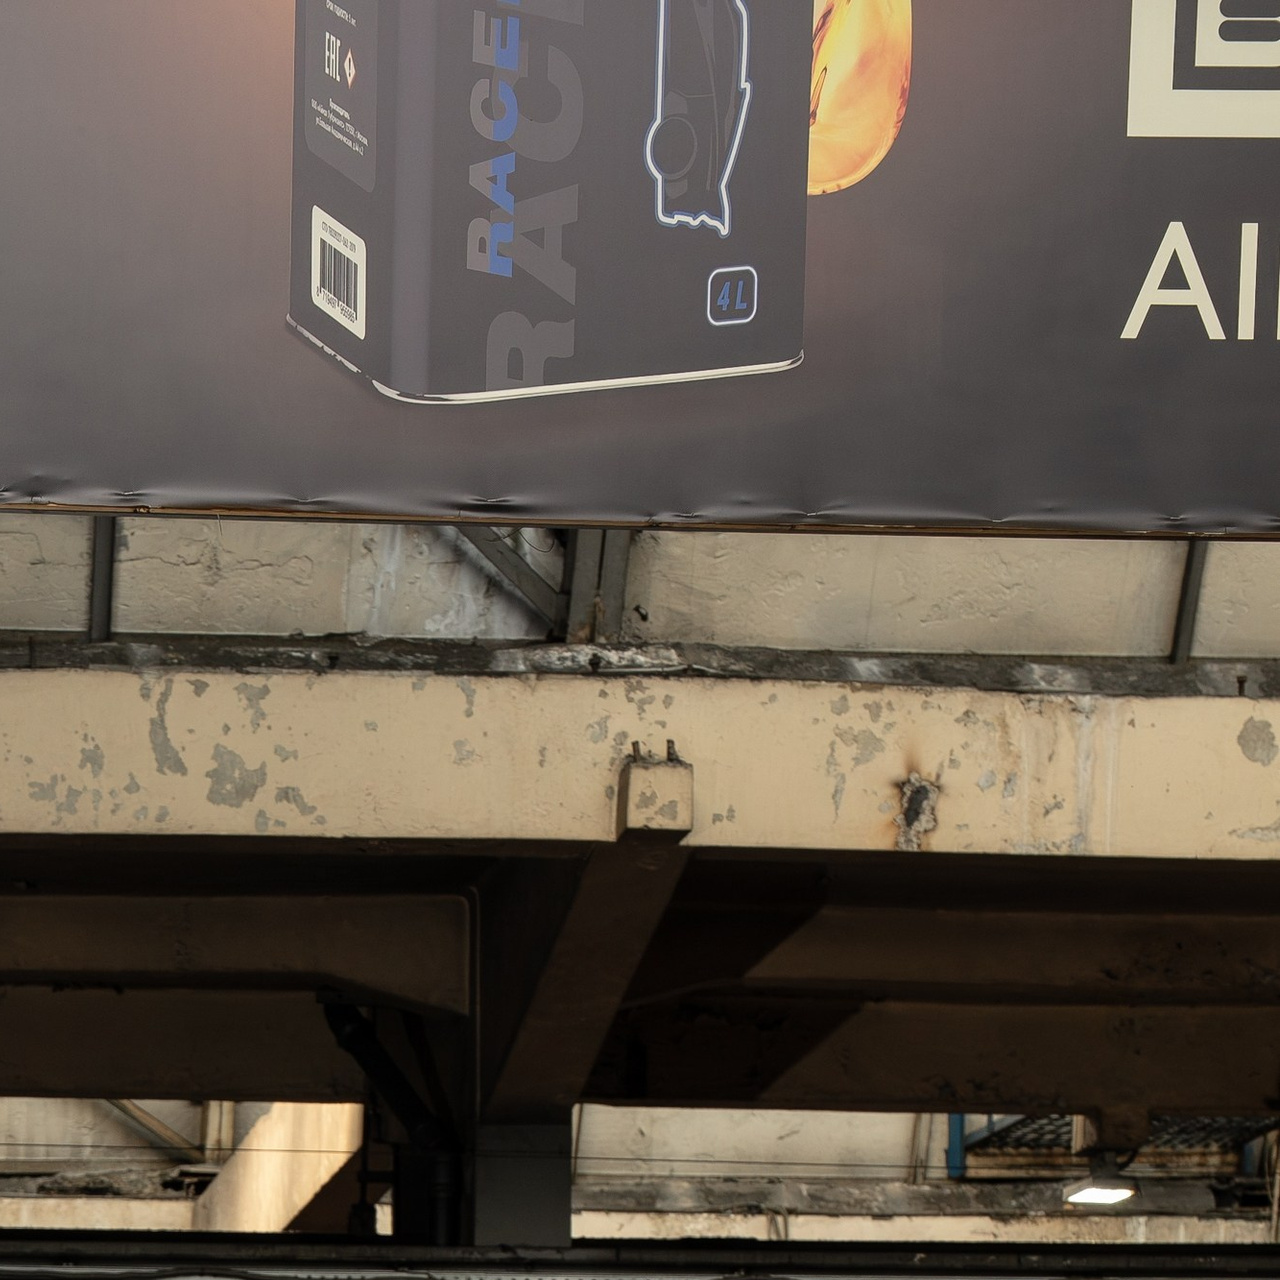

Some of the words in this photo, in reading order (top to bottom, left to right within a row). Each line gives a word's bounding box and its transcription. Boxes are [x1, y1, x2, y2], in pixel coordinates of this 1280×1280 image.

[467, 0, 521, 278] RACE
[717, 281, 730, 310] 4
[735, 280, 747, 309] L
[1120, 222, 1280, 340] AI
